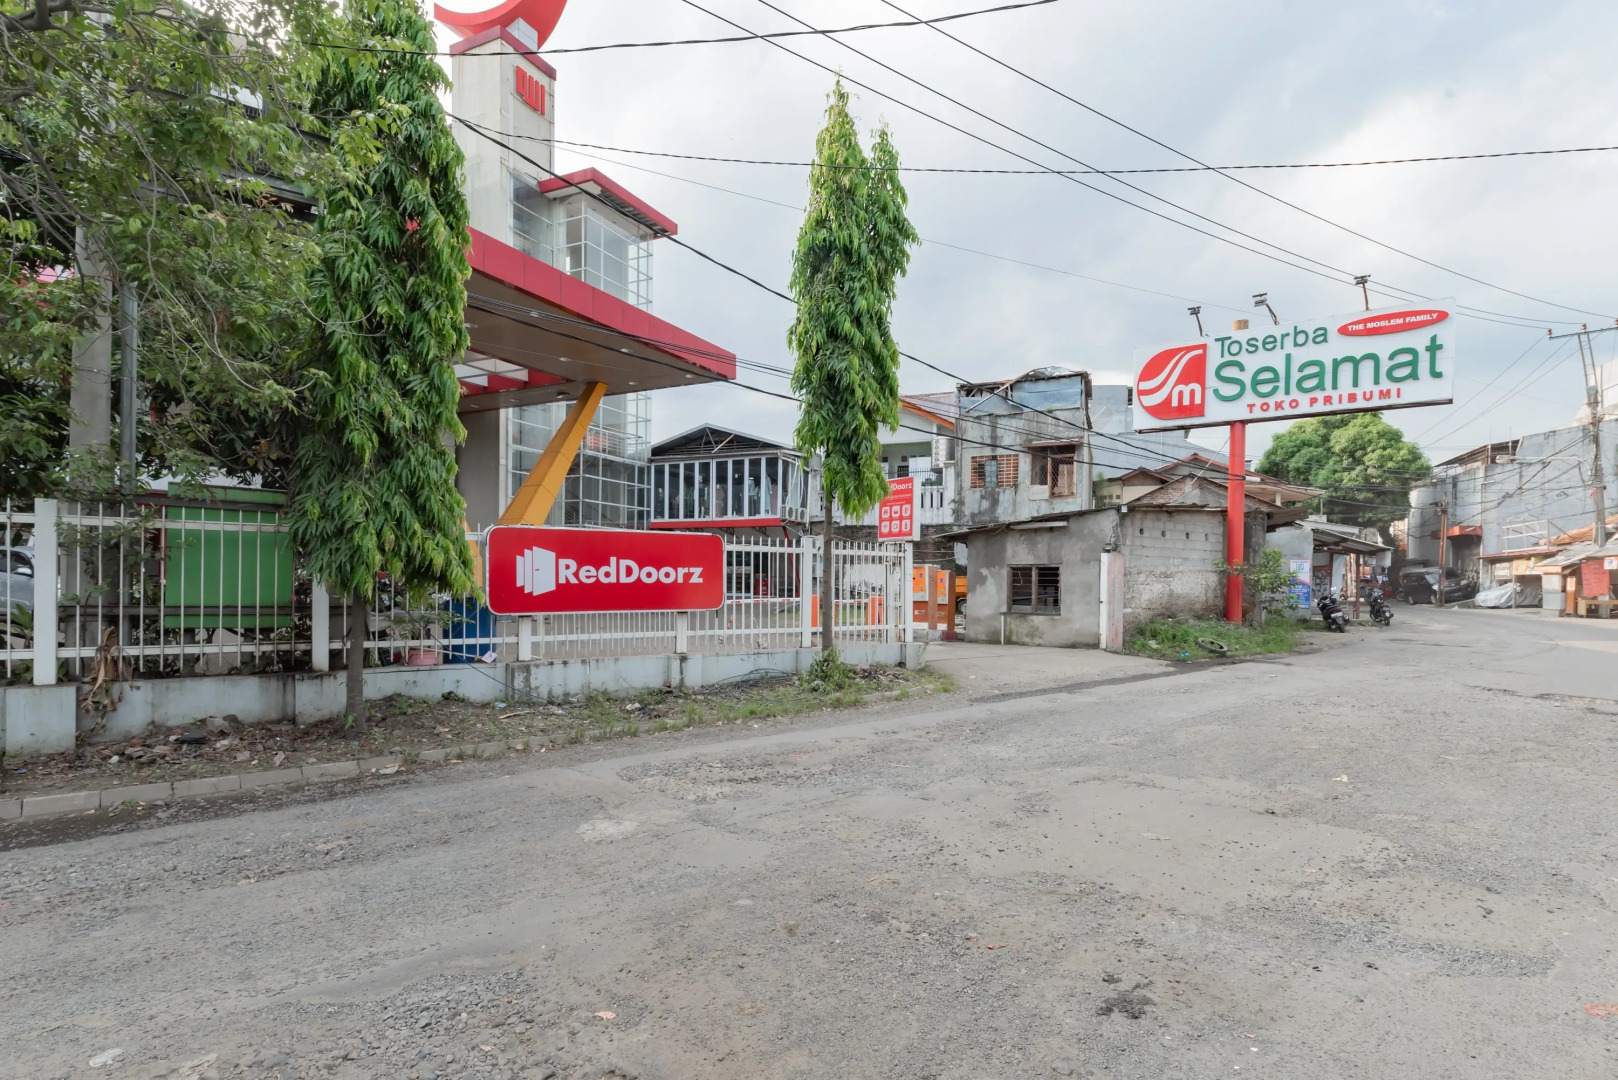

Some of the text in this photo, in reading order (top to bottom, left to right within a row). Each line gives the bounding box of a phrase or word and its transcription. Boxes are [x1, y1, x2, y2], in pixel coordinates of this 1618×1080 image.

[1347, 312, 1439, 331] THE MOSLEM FAMILY
[1214, 325, 1329, 358] Toserba
[1212, 333, 1444, 402] Selamat
[1246, 387, 1401, 414] TOKO PRIBUMI
[558, 556, 704, 584] RedDoorz
